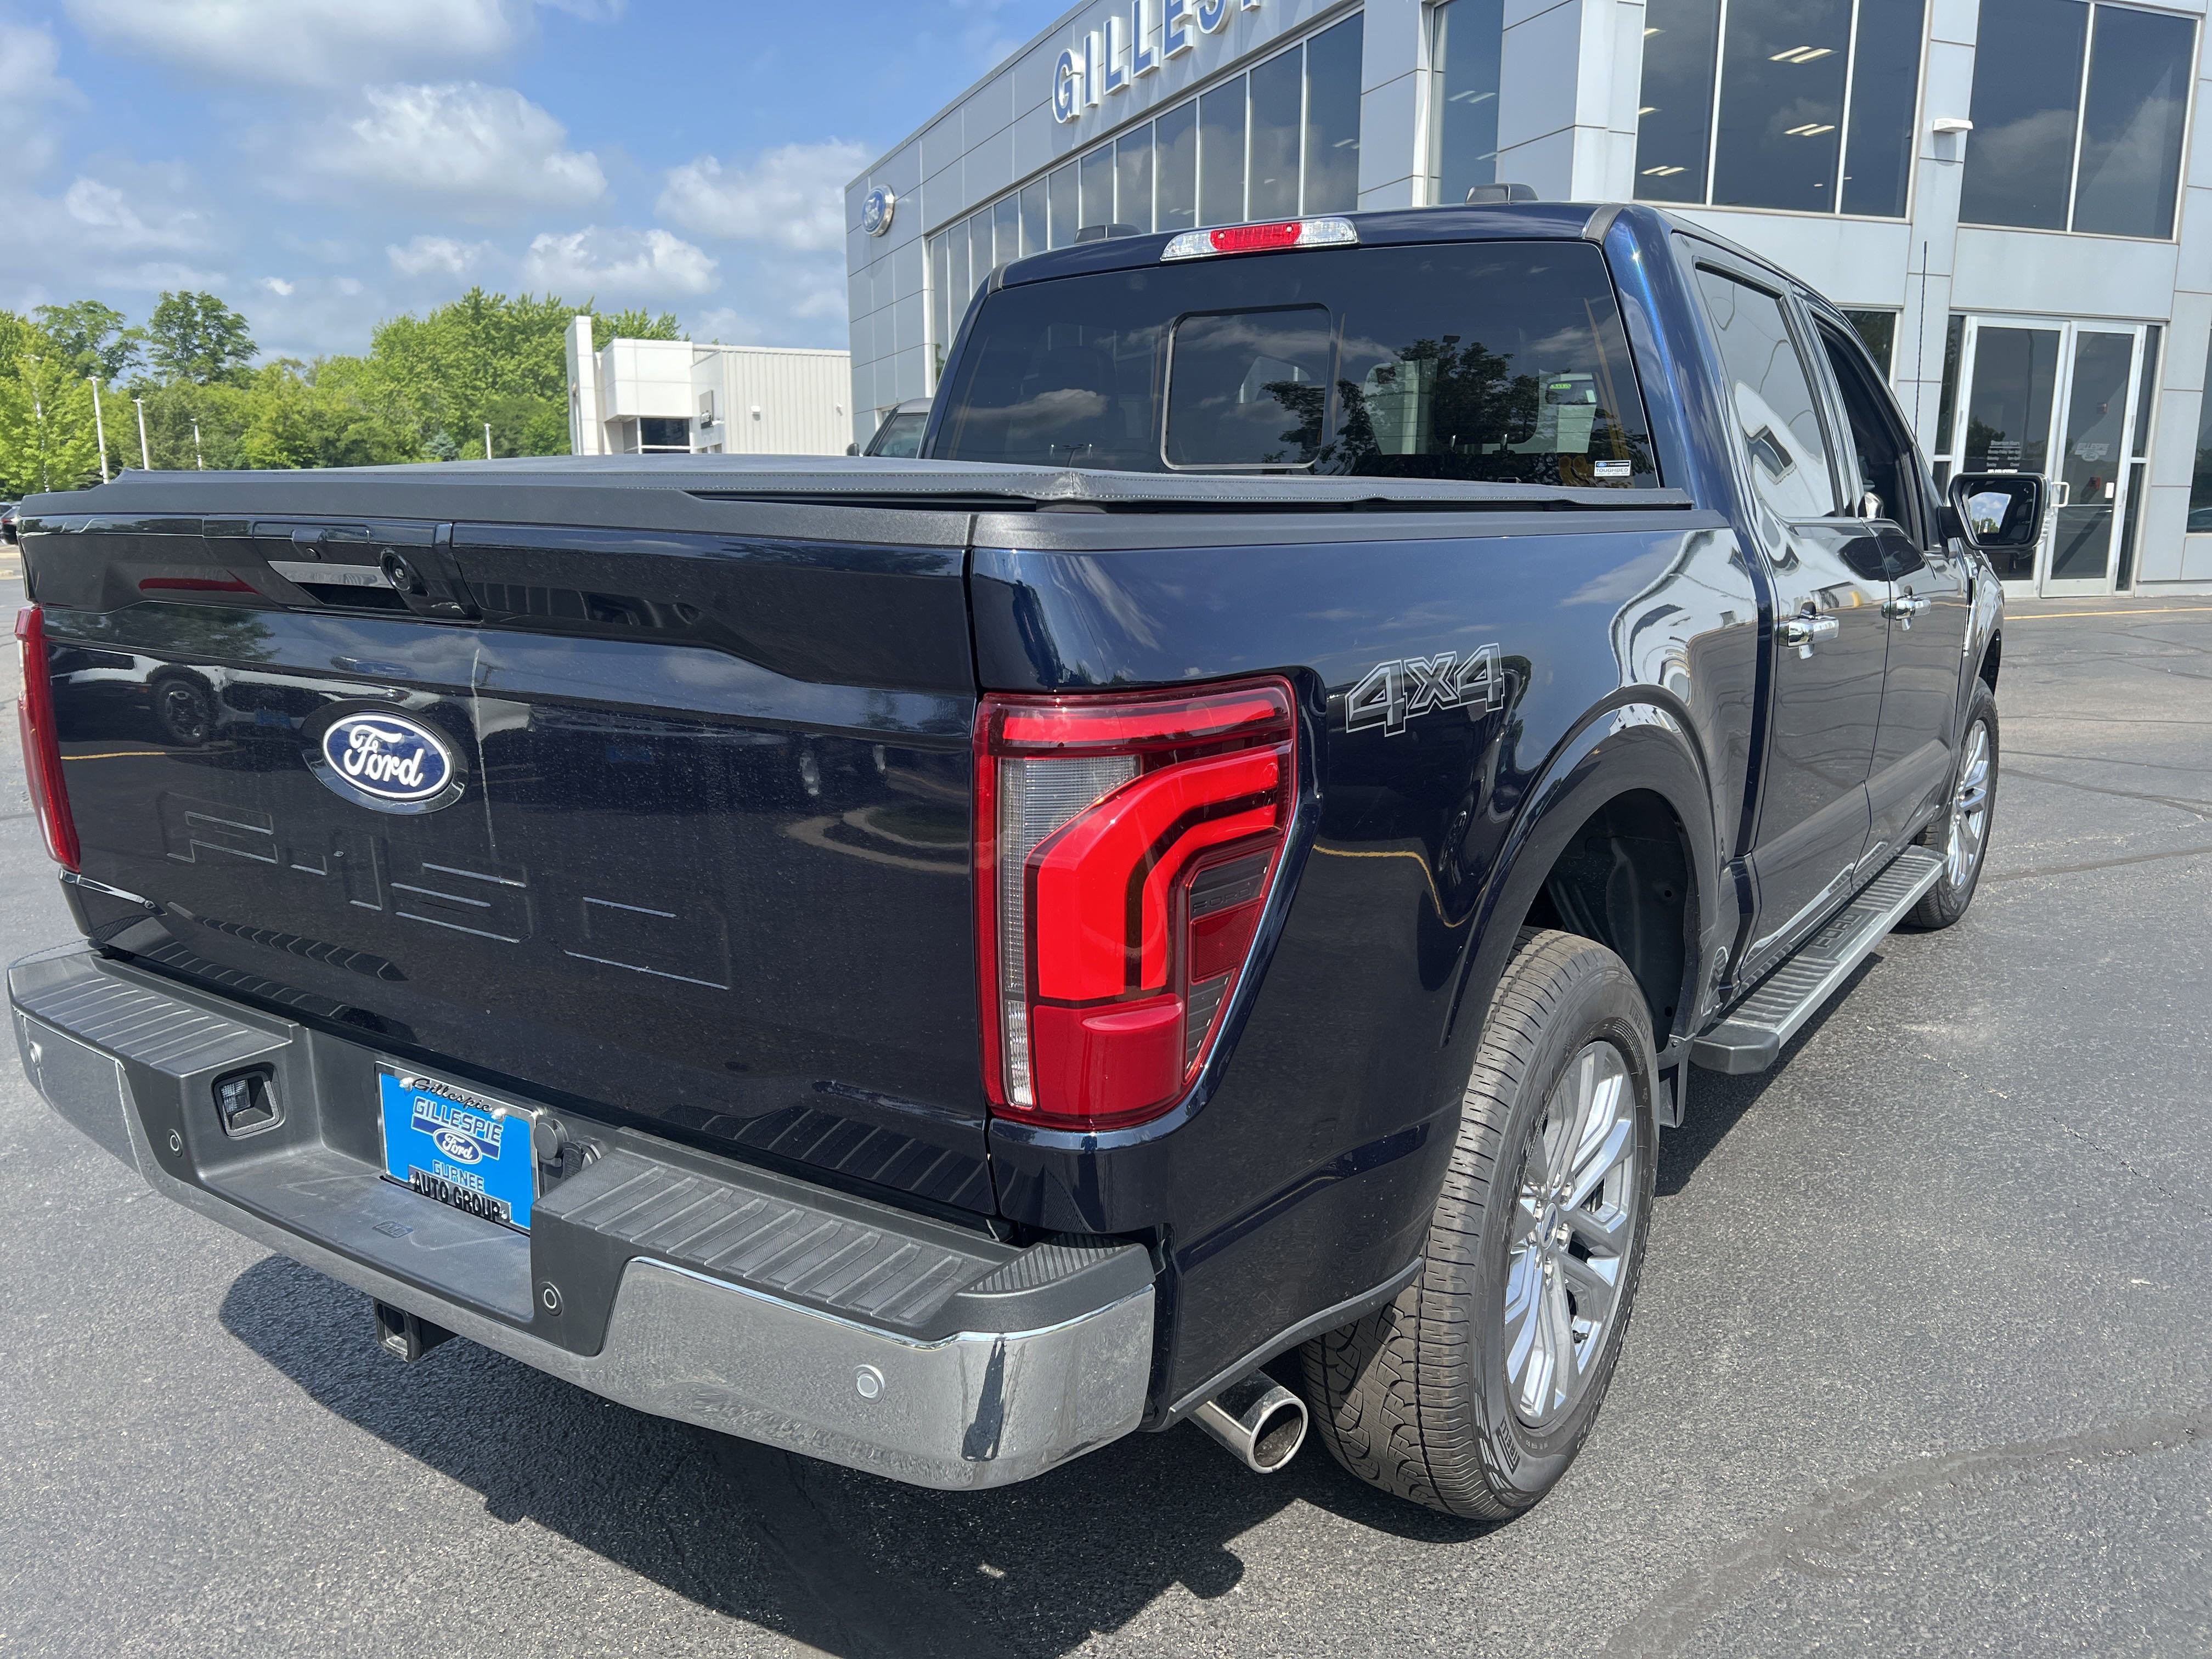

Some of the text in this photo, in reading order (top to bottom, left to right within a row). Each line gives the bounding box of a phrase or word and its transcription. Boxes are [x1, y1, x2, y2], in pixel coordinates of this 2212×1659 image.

[343, 724, 425, 787] Ford
[1808, 913, 1863, 949] FORD
[412, 1078, 493, 1113] Gillespie
[413, 1096, 504, 1144] GILLESPIE
[442, 1133, 474, 1159] Ford
[415, 1171, 501, 1221] AUTO GROUP
[432, 1159, 484, 1193] GURNEE
[1496, 1415, 1521, 1475] PIRELLI
